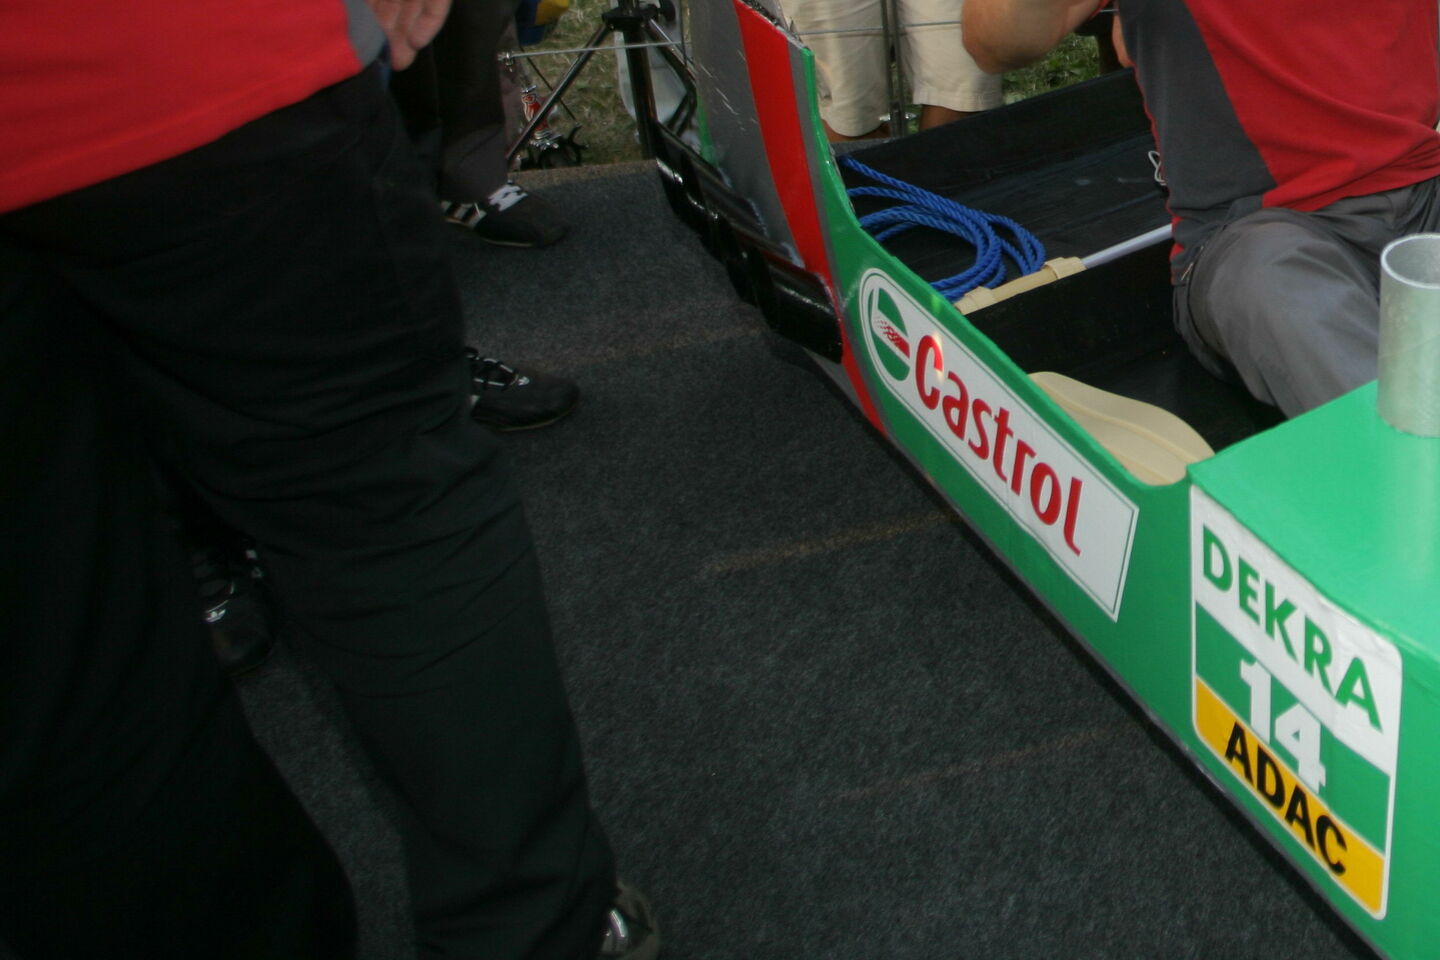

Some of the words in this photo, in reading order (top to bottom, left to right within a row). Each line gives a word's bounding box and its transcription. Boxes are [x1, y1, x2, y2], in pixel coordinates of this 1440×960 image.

[914, 334, 1083, 557] Castrol
[1202, 523, 1384, 733] DEKRA
[1224, 721, 1347, 876] ADAC
[1240, 658, 1327, 795] 14
